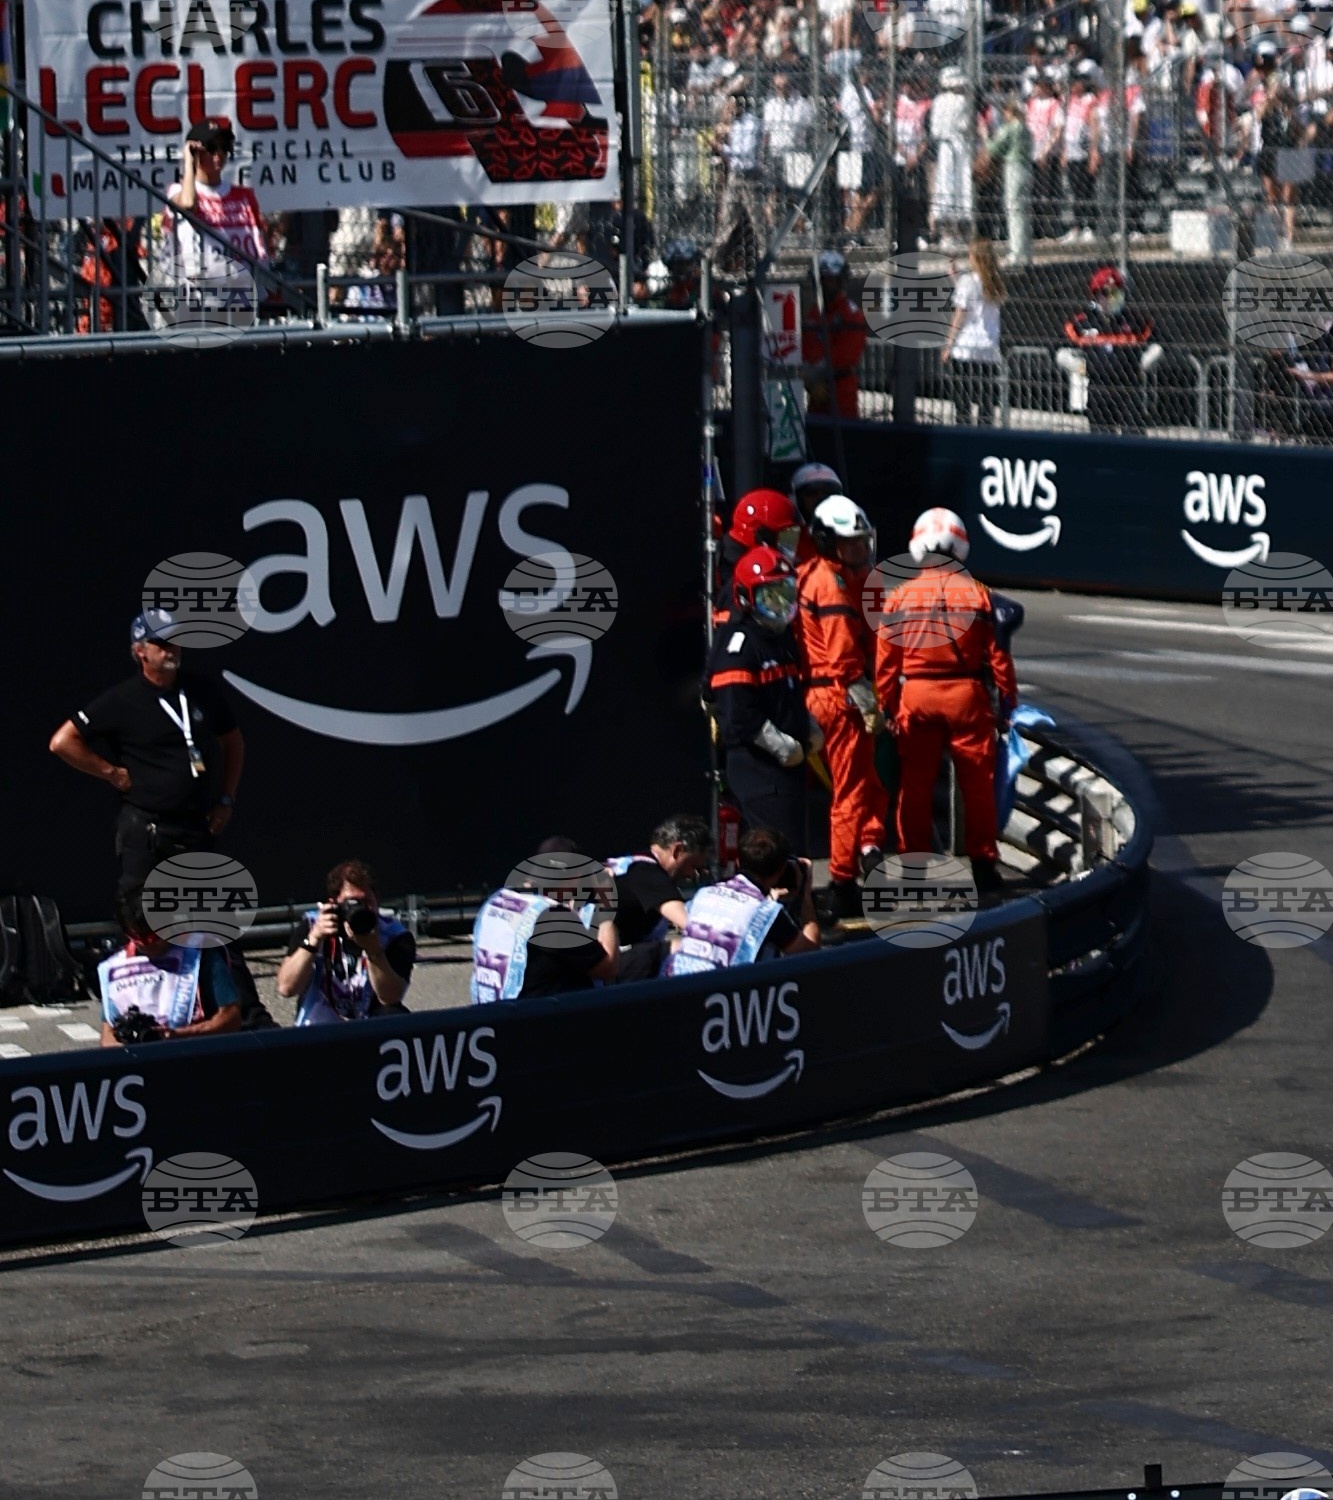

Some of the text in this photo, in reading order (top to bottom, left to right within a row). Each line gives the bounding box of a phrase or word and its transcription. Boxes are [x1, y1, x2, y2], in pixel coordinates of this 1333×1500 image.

[40, 57, 379, 138] LECLERC
[409, 60, 502, 126] 16
[116, 138, 354, 165] THE FFICIAL
[238, 163, 298, 187] FAN
[318, 160, 397, 183] CLUB
[980, 456, 1057, 510] aws
[1183, 471, 1266, 527] aws
[236, 483, 577, 633] aws
[942, 936, 1006, 1005] aws
[700, 981, 801, 1053] aws
[376, 1027, 498, 1100] aws
[7, 1076, 146, 1149] aws
